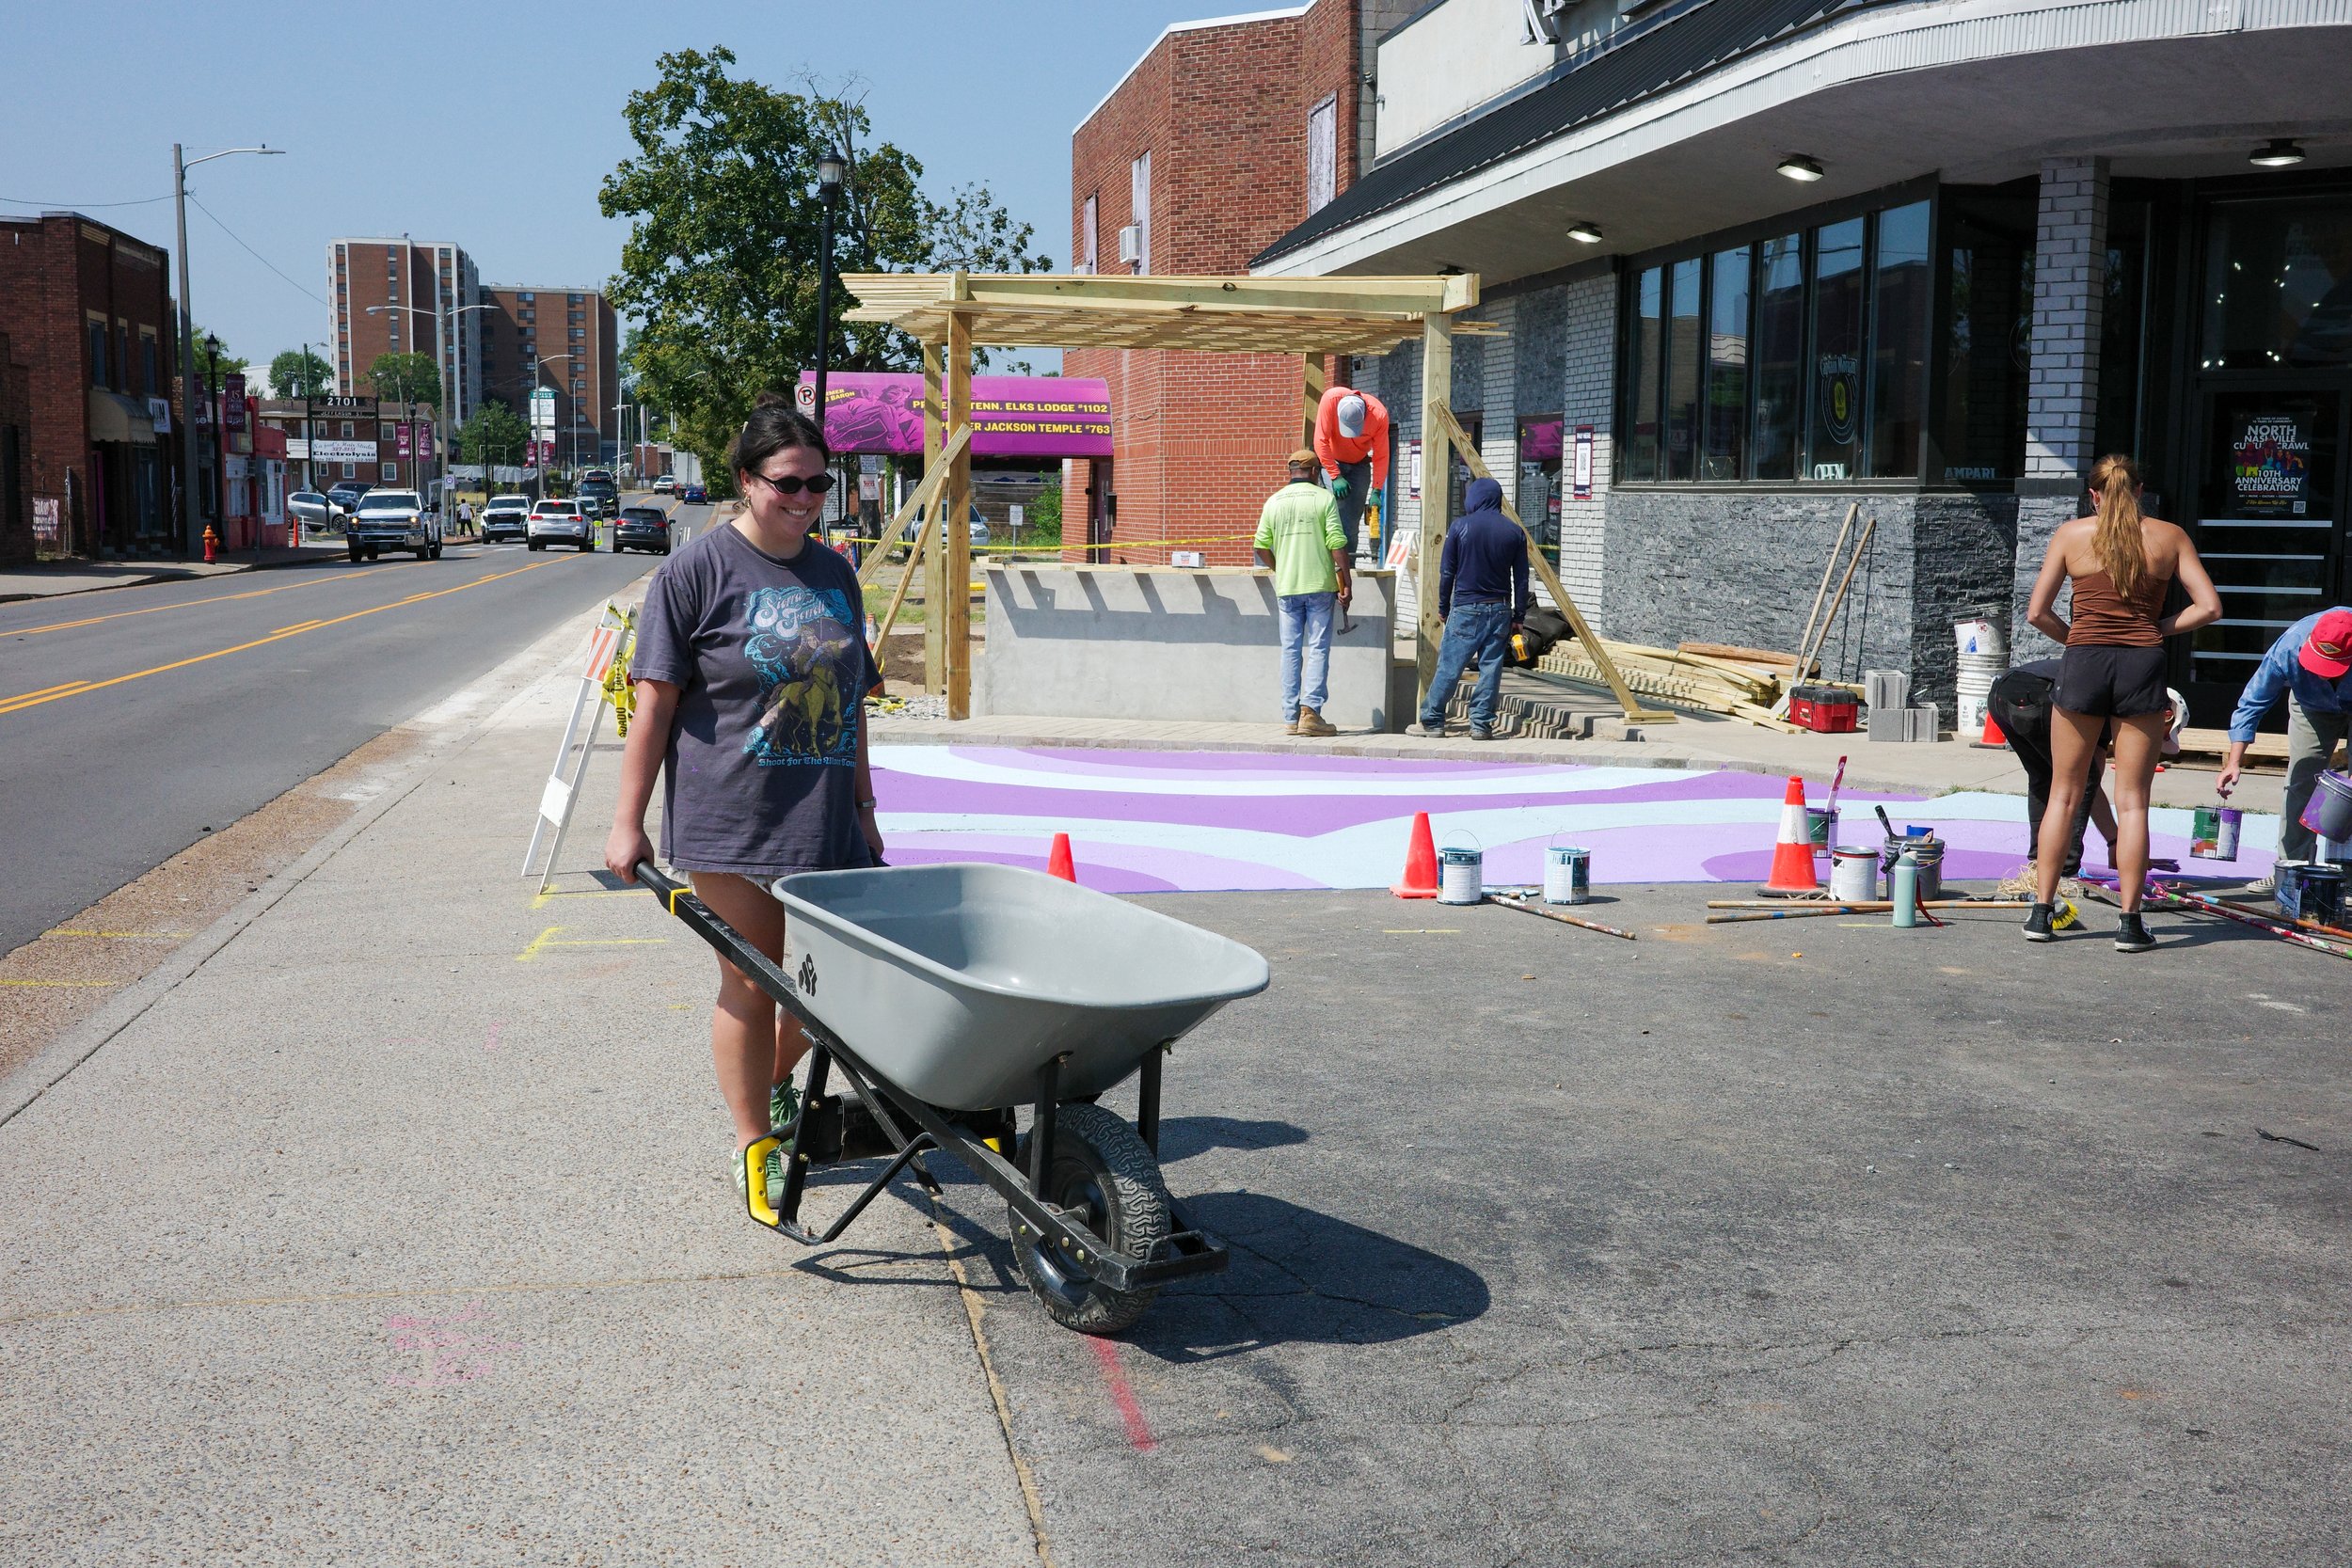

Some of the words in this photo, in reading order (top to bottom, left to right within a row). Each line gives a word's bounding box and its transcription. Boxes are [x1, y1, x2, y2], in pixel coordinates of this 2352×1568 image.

[831, 391, 855, 401] BARON
[326, 397, 357, 406] 2701
[1006, 403, 1035, 412] ELKS
[1038, 403, 1075, 413] LODGE
[1077, 404, 1108, 414] #1102
[984, 422, 1036, 433] JACKSON
[1039, 423, 1083, 434] TEMPLE
[1085, 424, 1110, 435] #763
[2248, 425, 2297, 436] NORTH
[1814, 464, 1845, 480] OPEN
[2258, 469, 2281, 478] 10TH
[2237, 483, 2299, 492] CELEBRATION
[754, 593, 803, 628] Sierra
[757, 758, 786, 767] Shoot
